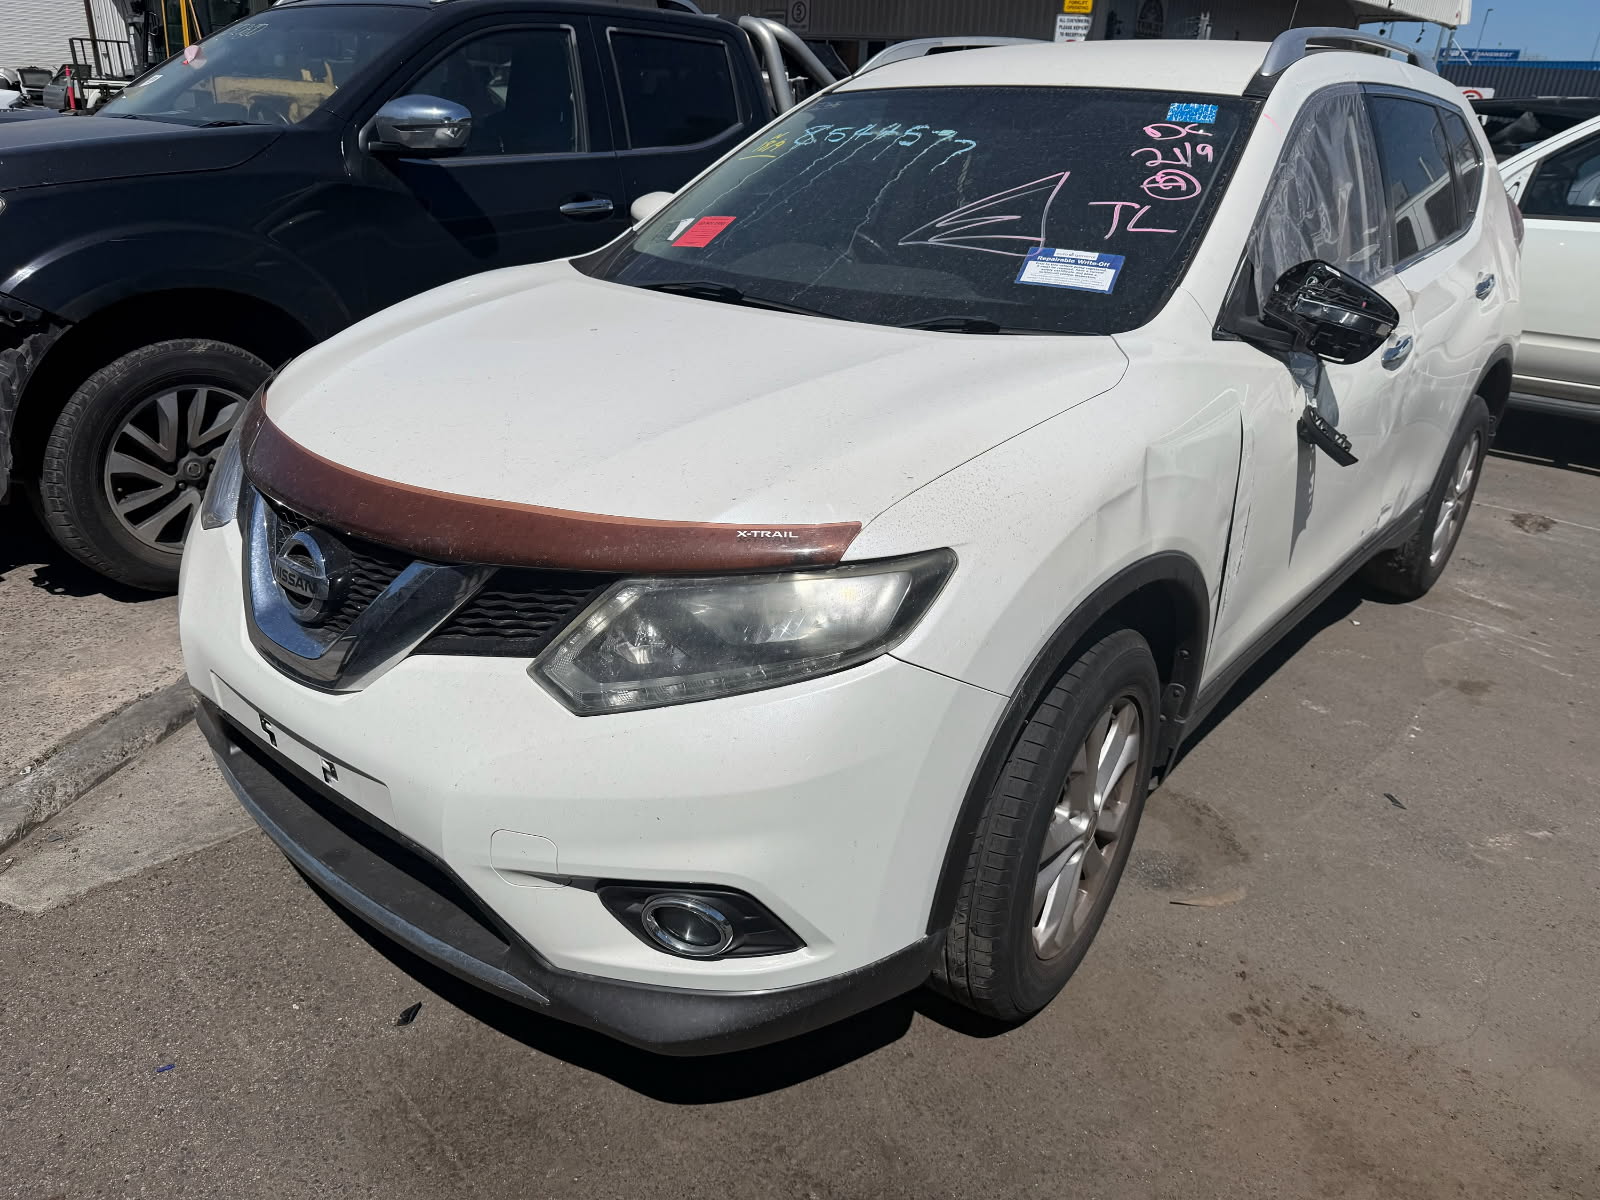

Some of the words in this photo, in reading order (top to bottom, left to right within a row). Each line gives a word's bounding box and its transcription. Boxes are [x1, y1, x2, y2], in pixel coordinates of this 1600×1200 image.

[1037, 255, 1076, 264] Repairable
[1077, 259, 1111, 268] Write-Off
[736, 530, 799, 538] X-TRAIL
[275, 565, 319, 594] NISSAN
